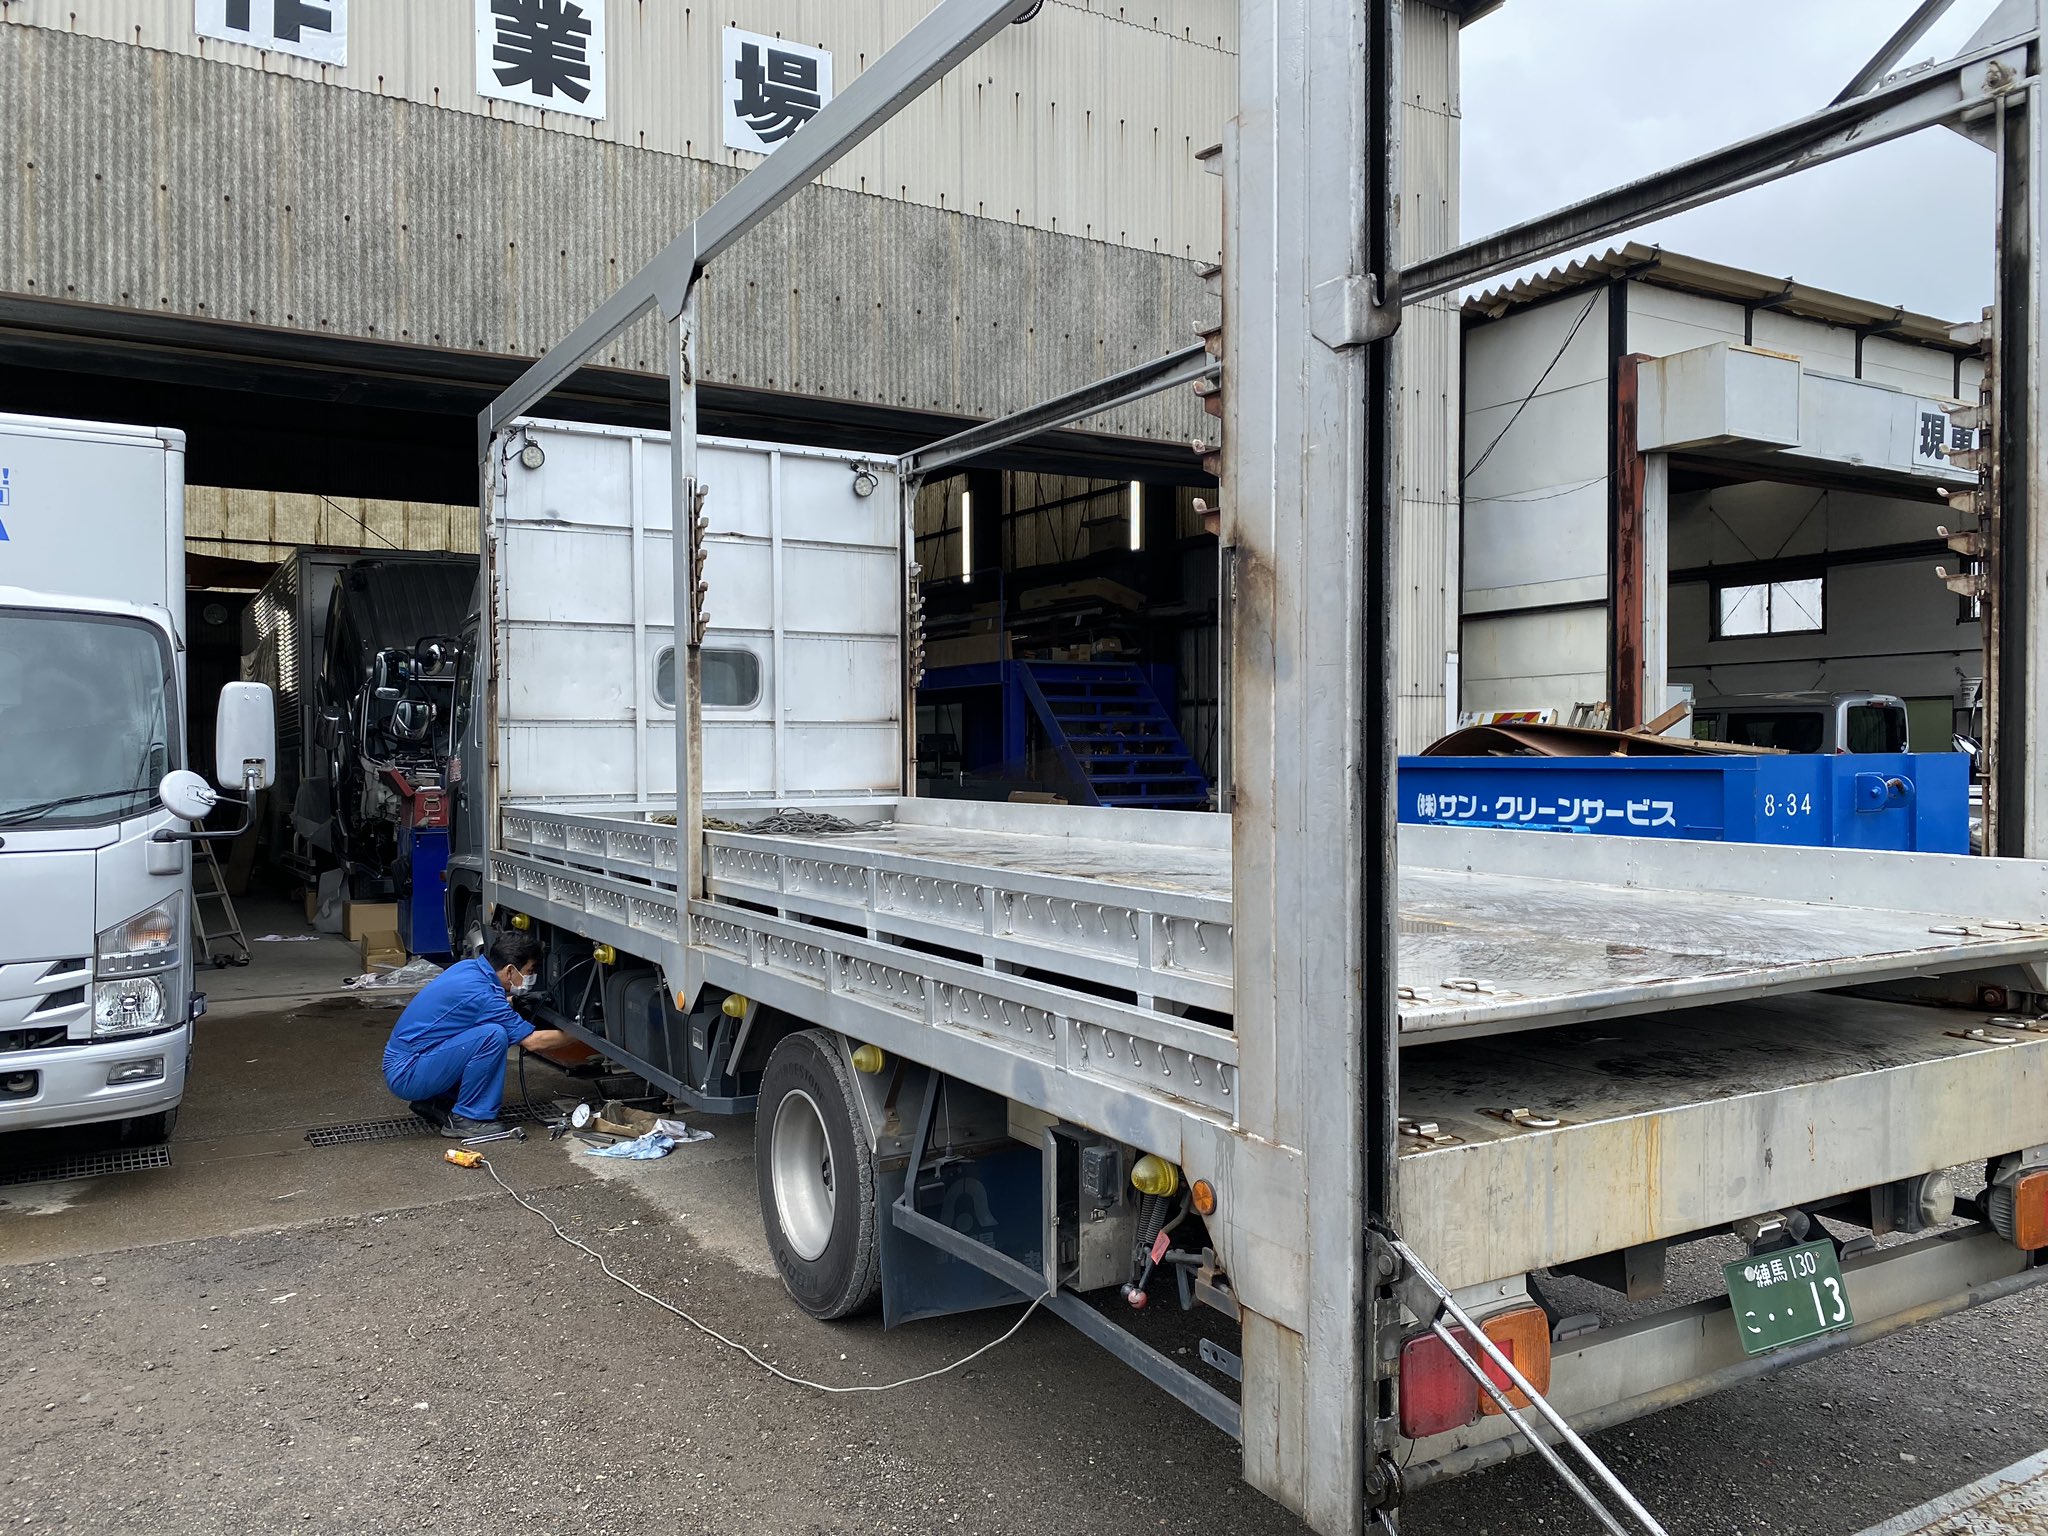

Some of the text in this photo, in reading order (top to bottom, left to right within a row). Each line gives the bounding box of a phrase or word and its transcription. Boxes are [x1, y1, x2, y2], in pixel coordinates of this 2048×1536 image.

[1754, 1251, 1817, 1288] 練馬 130
[1810, 1276, 1846, 1327] 13
